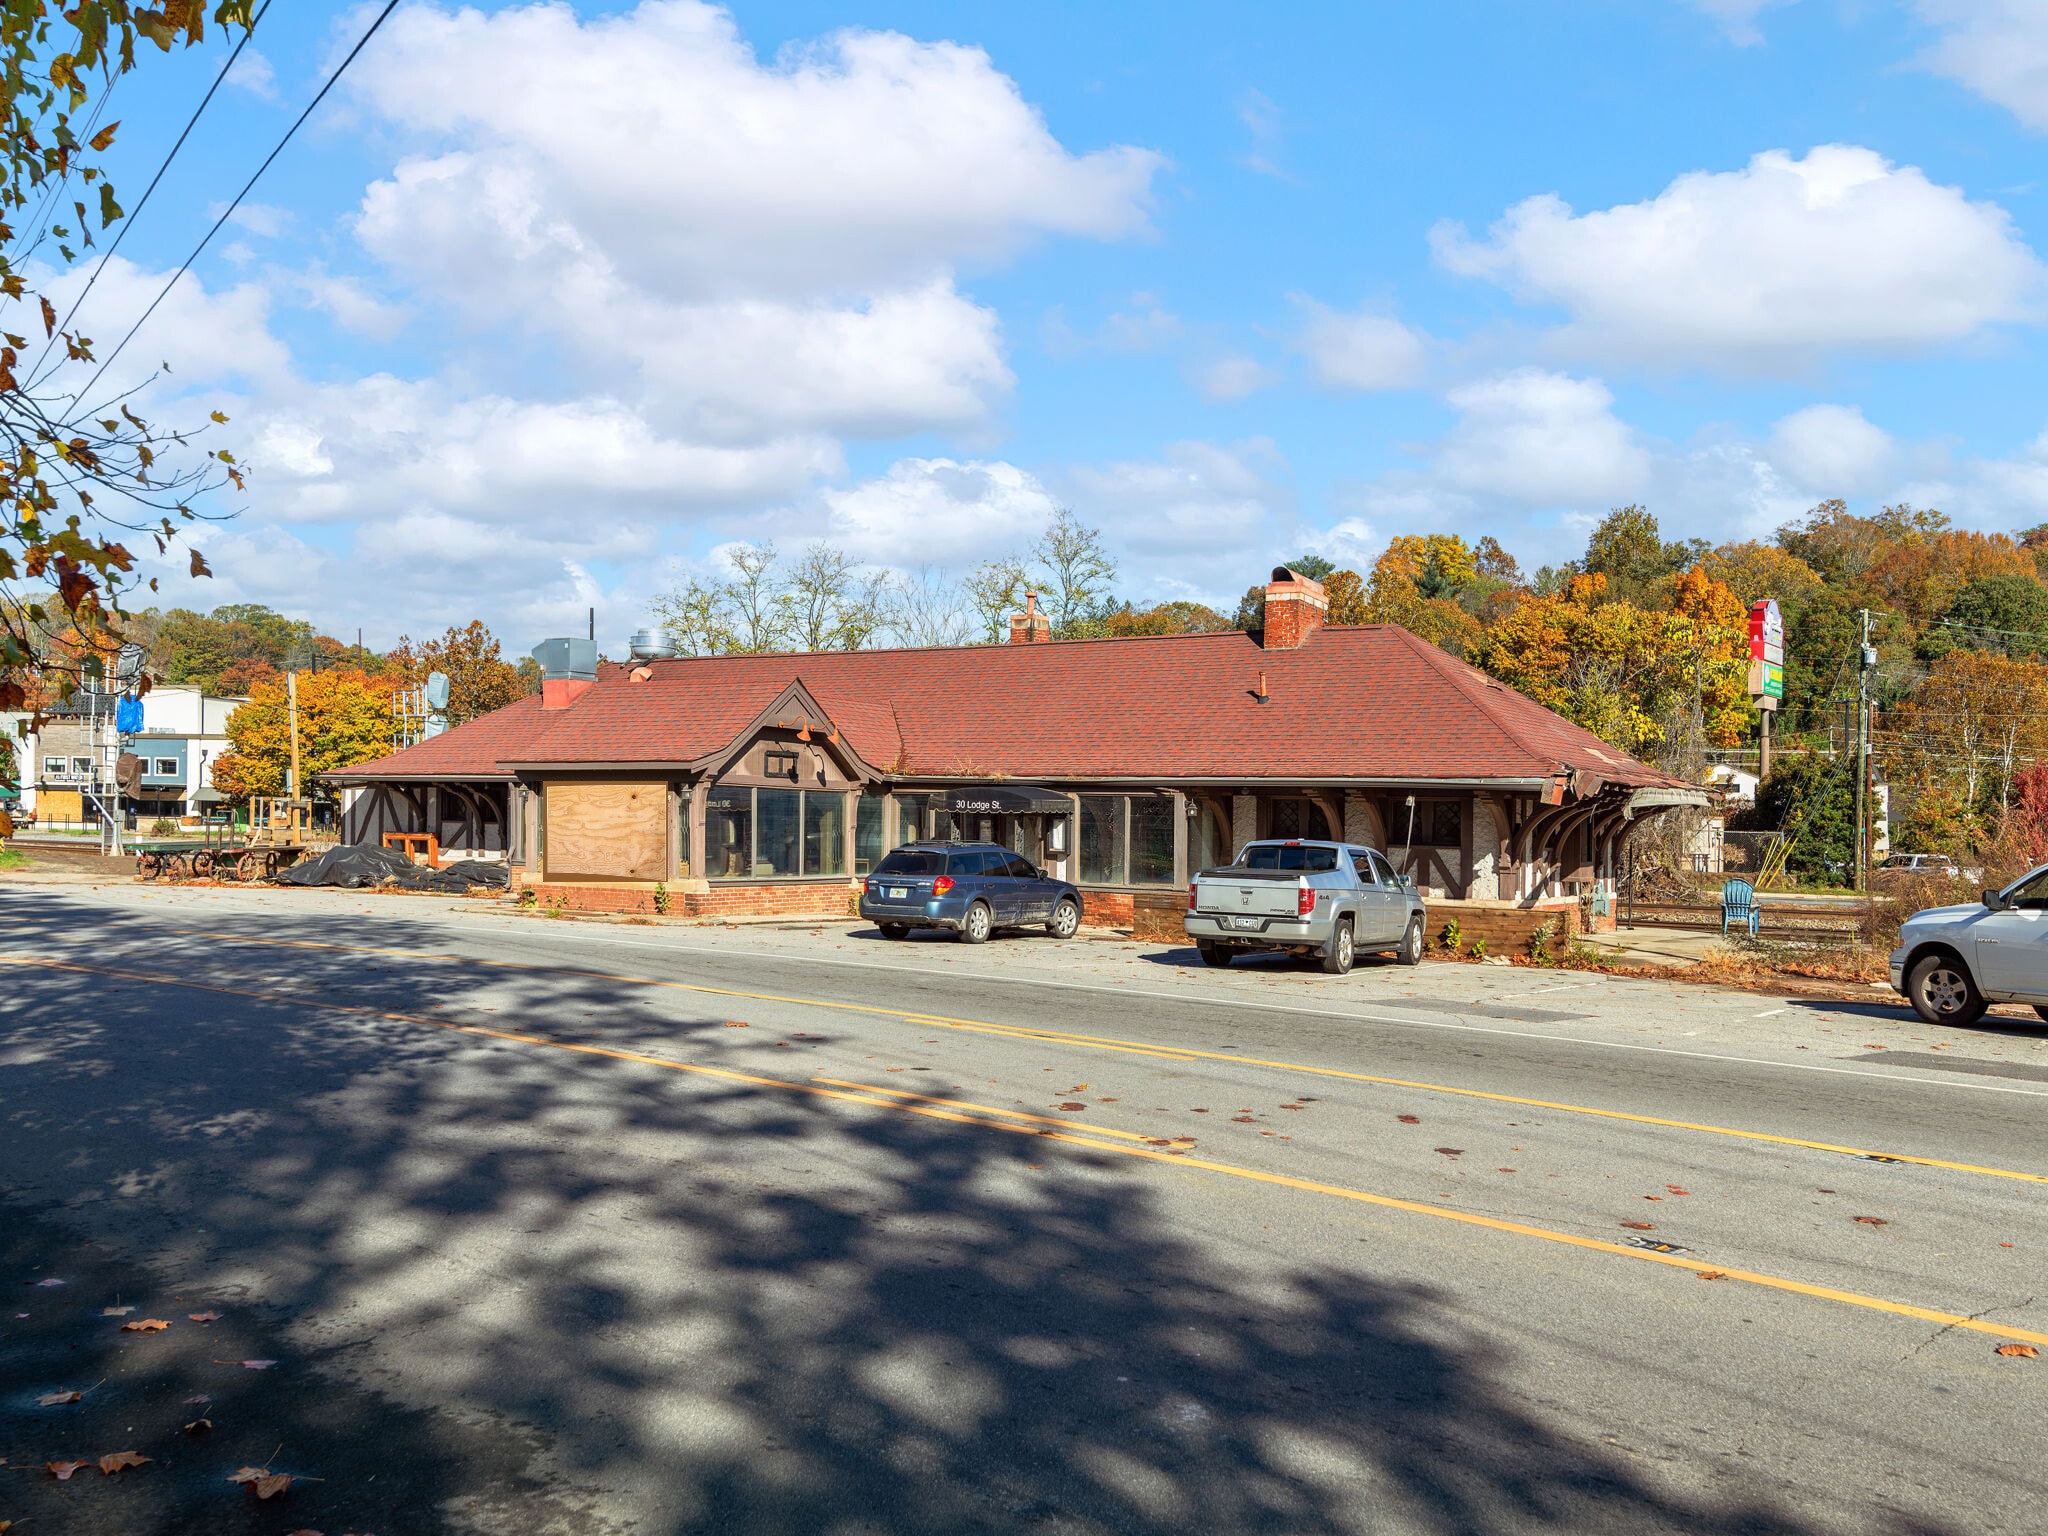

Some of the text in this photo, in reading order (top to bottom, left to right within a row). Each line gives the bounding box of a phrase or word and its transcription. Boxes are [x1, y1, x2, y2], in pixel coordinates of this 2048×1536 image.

[956, 800, 1002, 810] 30 Lodge St.
